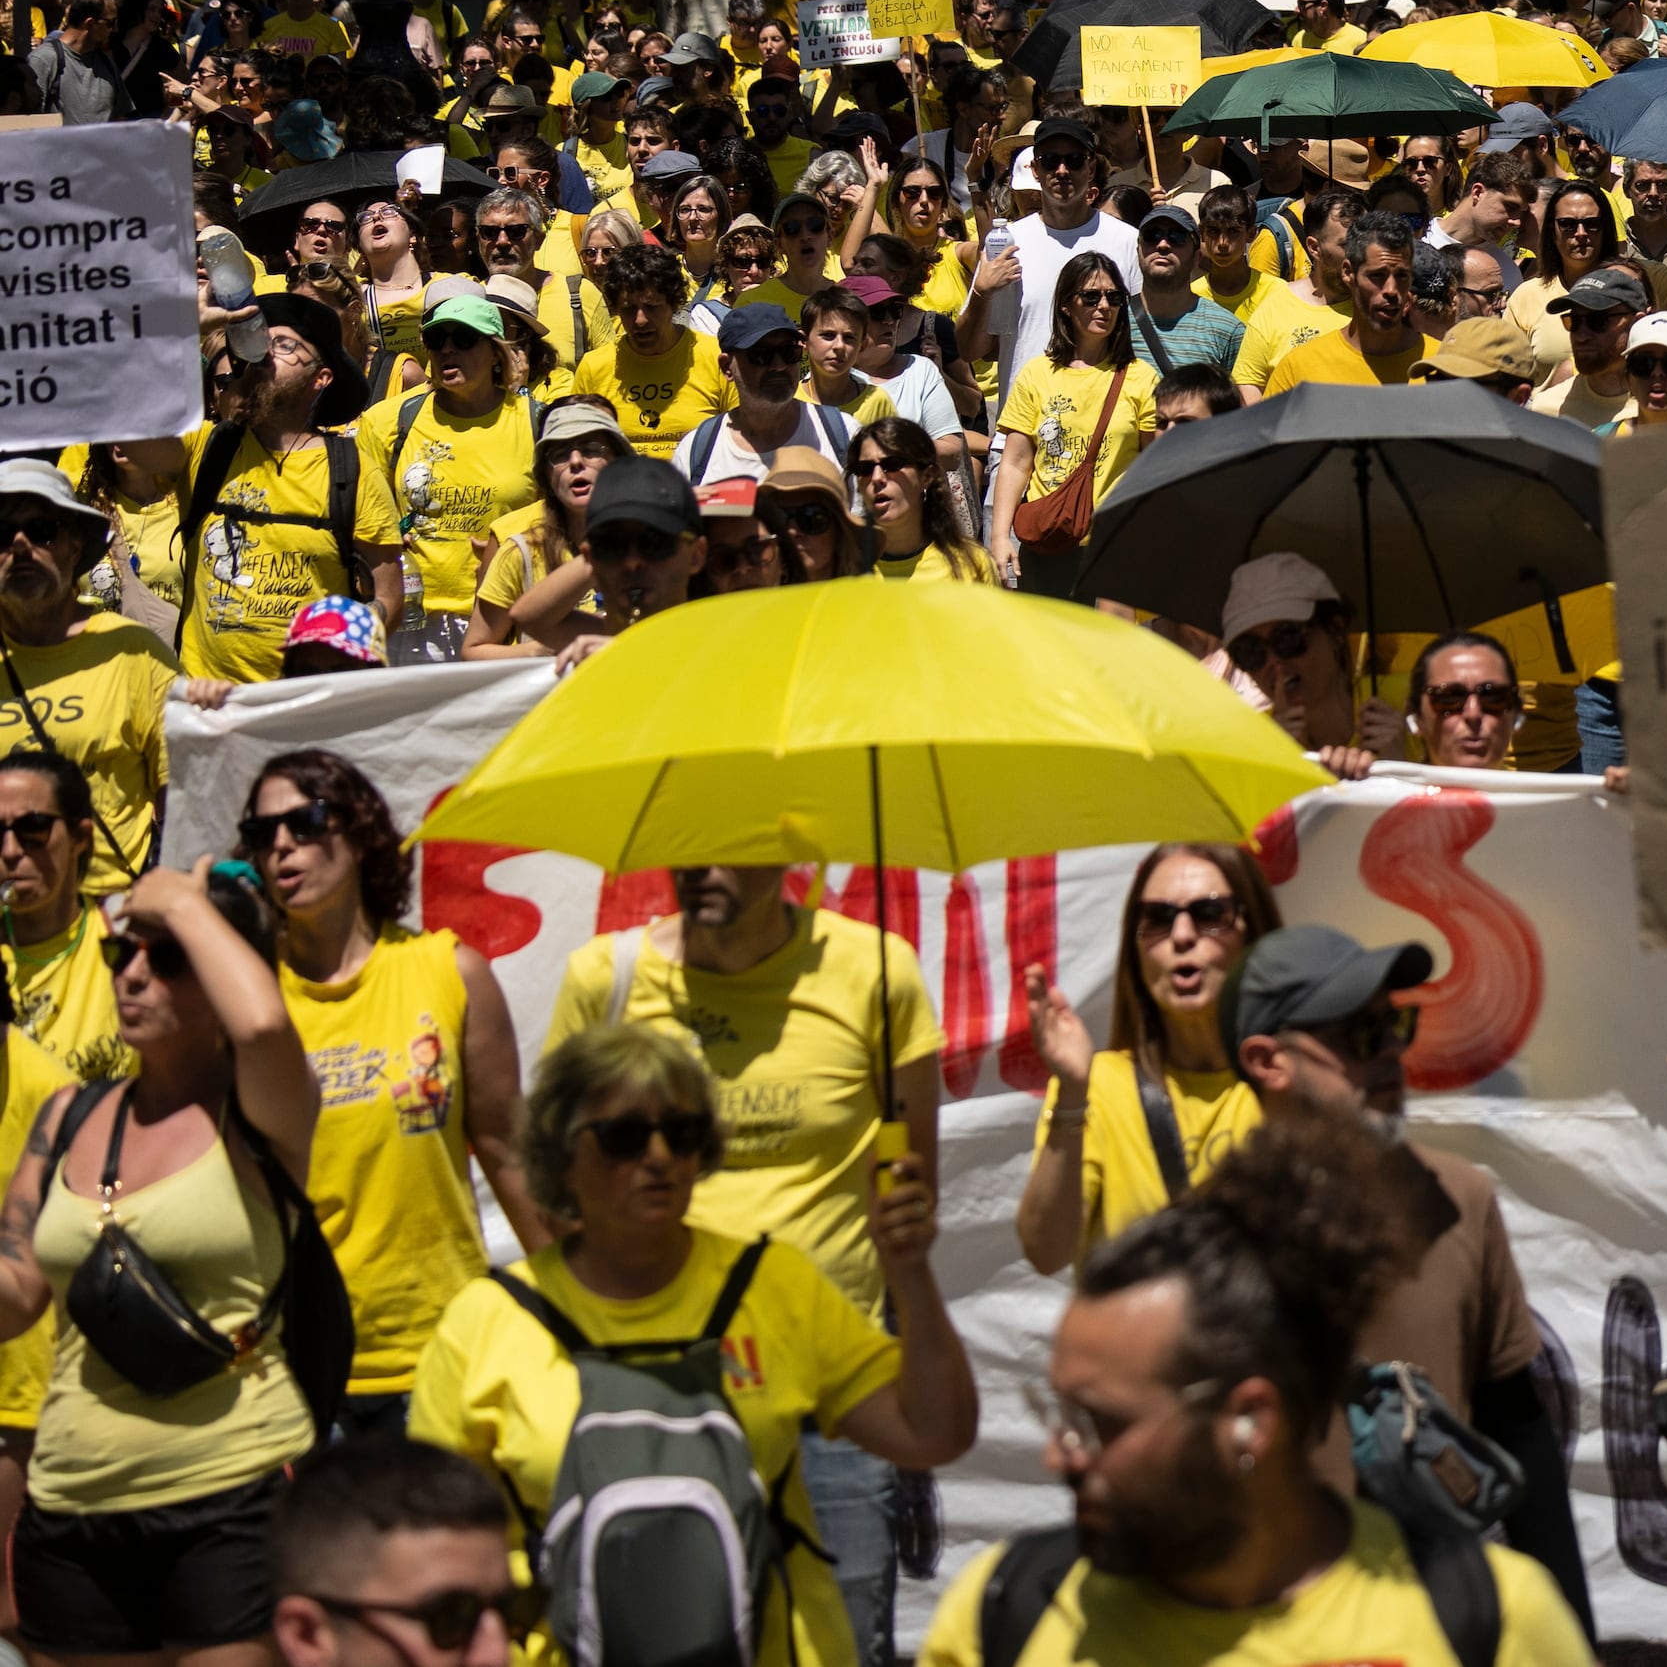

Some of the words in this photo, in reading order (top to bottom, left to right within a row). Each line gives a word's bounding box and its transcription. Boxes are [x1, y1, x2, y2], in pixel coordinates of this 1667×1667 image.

[817, 2, 868, 15] PRECARITZ
[874, 1, 927, 14] L'ESCOLA
[828, 33, 872, 45] MALTRAC
[1132, 35, 1152, 52] AL
[811, 47, 826, 61] LA
[832, 43, 883, 58] INCLUSIÓ
[1090, 59, 1184, 74] TANCAMENT
[1093, 84, 1111, 99] DE
[50, 176, 71, 200] a
[0, 216, 147, 252] compra
[0, 263, 131, 298] visites
[132, 304, 142, 339] i
[628, 383, 674, 403] SOS
[637, 445, 648, 454] DE
[651, 443, 678, 453] QUAL
